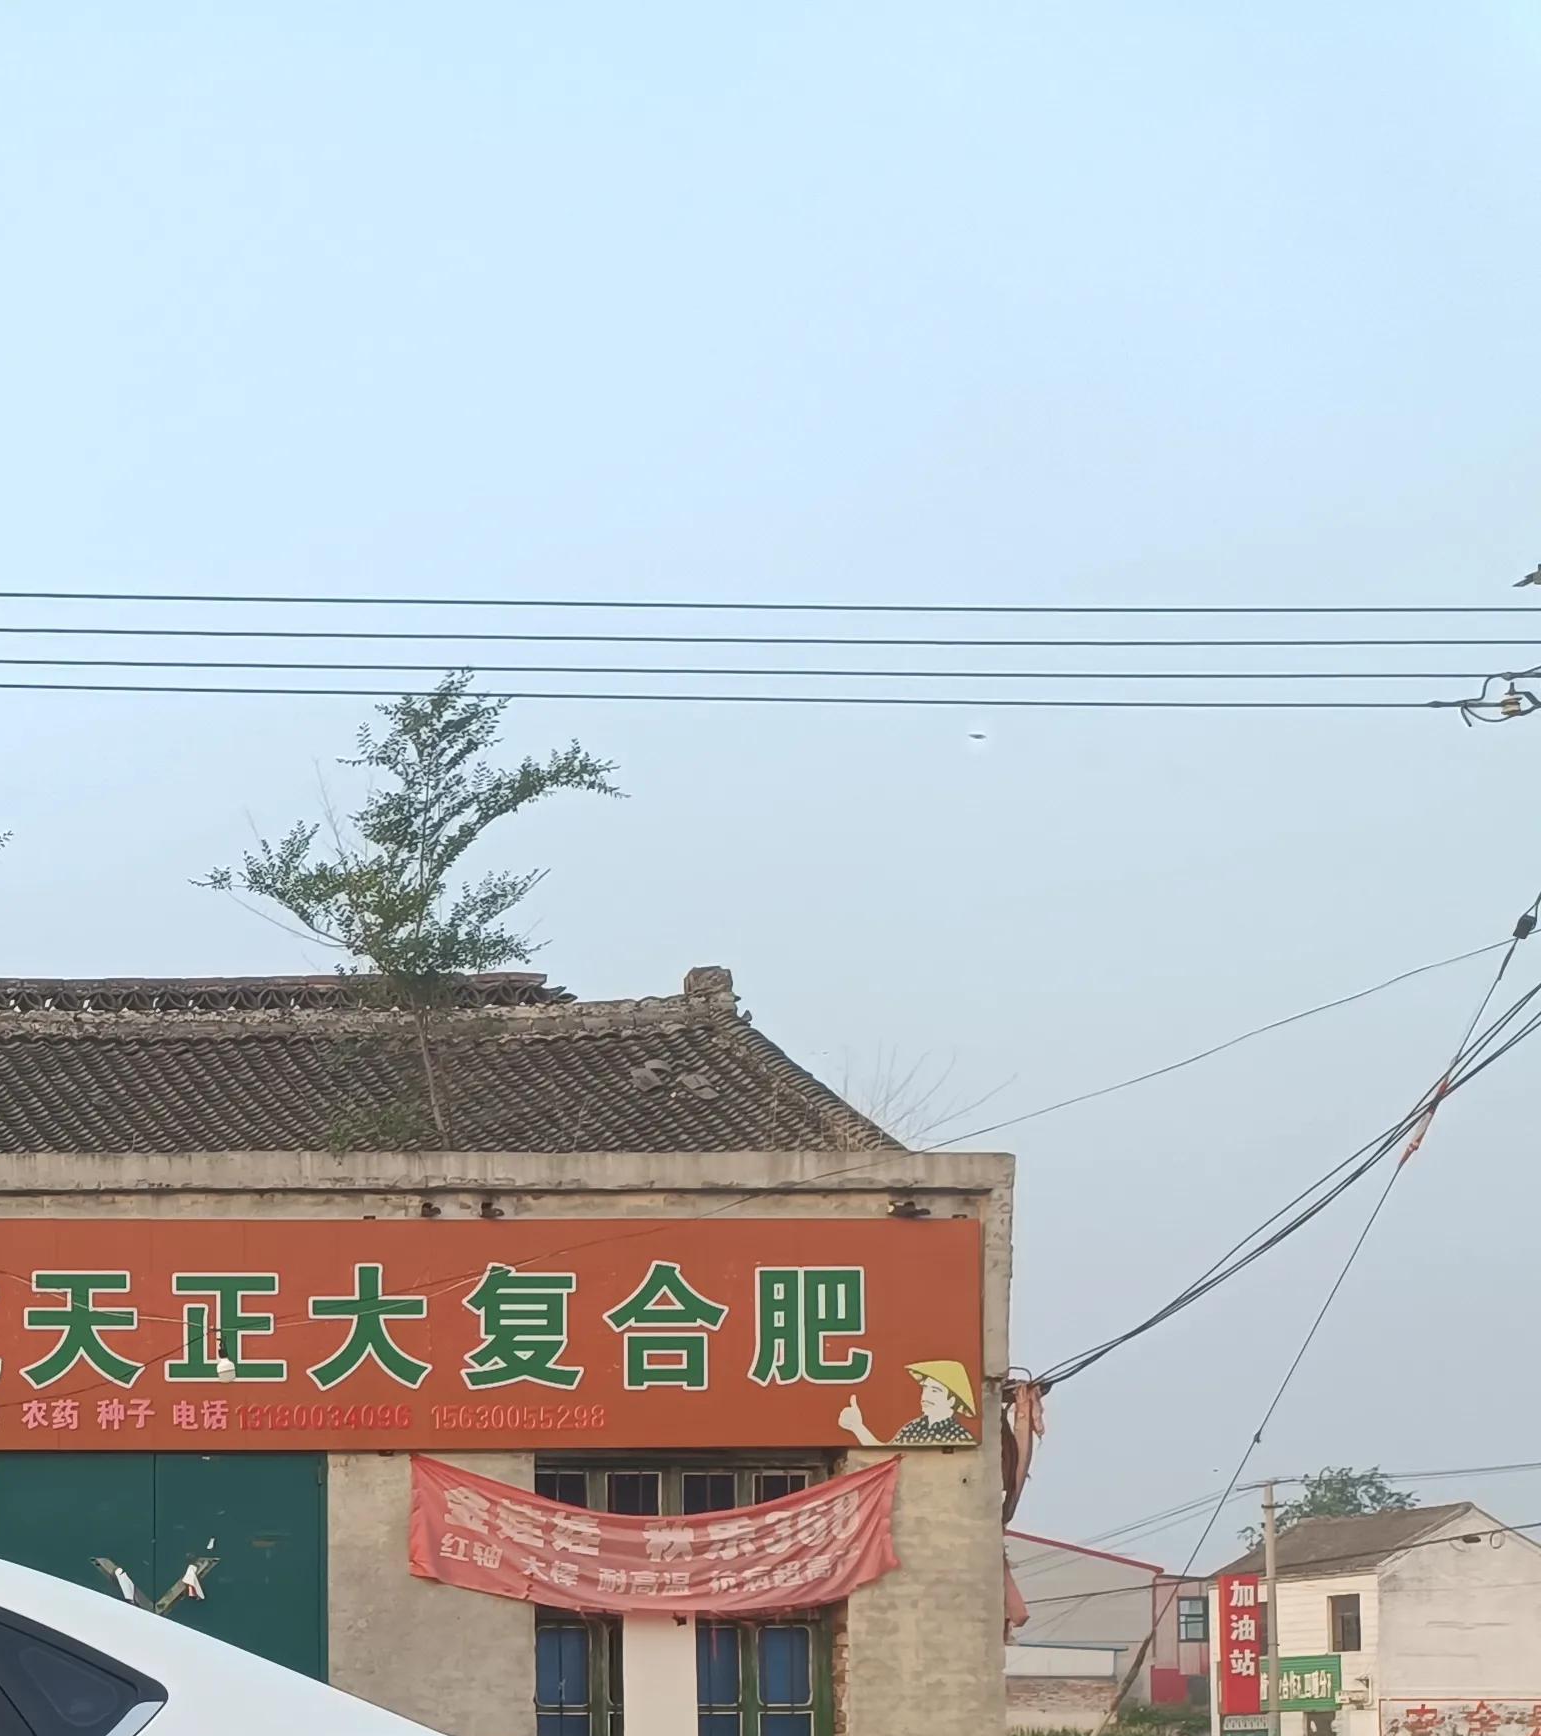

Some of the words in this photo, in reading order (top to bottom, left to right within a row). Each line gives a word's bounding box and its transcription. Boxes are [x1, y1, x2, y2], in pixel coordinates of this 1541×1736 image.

[20, 1399, 80, 1430] 农药
[96, 1398, 157, 1430] 种子
[1229, 1580, 1256, 1677] 加油站
